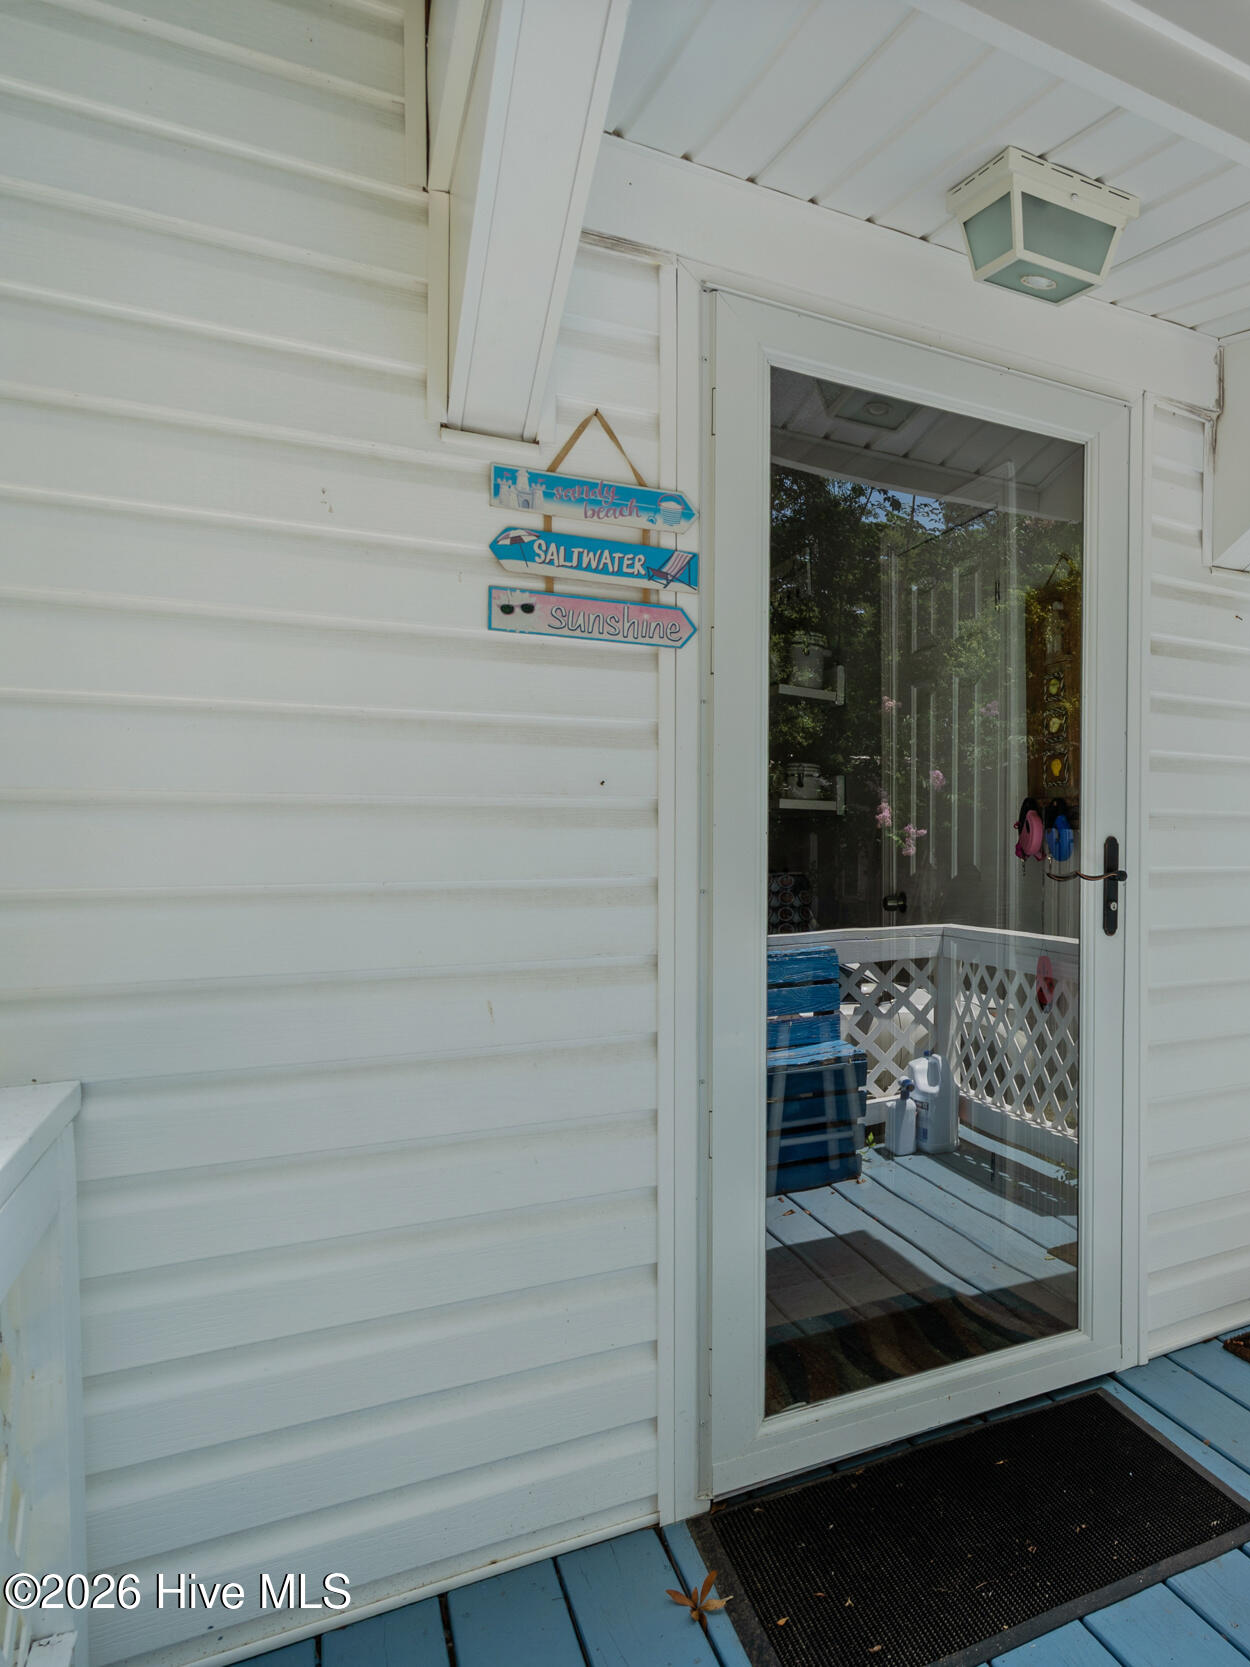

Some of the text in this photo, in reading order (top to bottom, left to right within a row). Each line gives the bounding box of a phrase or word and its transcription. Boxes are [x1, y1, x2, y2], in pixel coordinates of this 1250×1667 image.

[553, 480, 620, 505] sandy
[583, 498, 642, 520] beach
[533, 539, 647, 576] SALTWATER
[547, 605, 683, 642] sunshine
